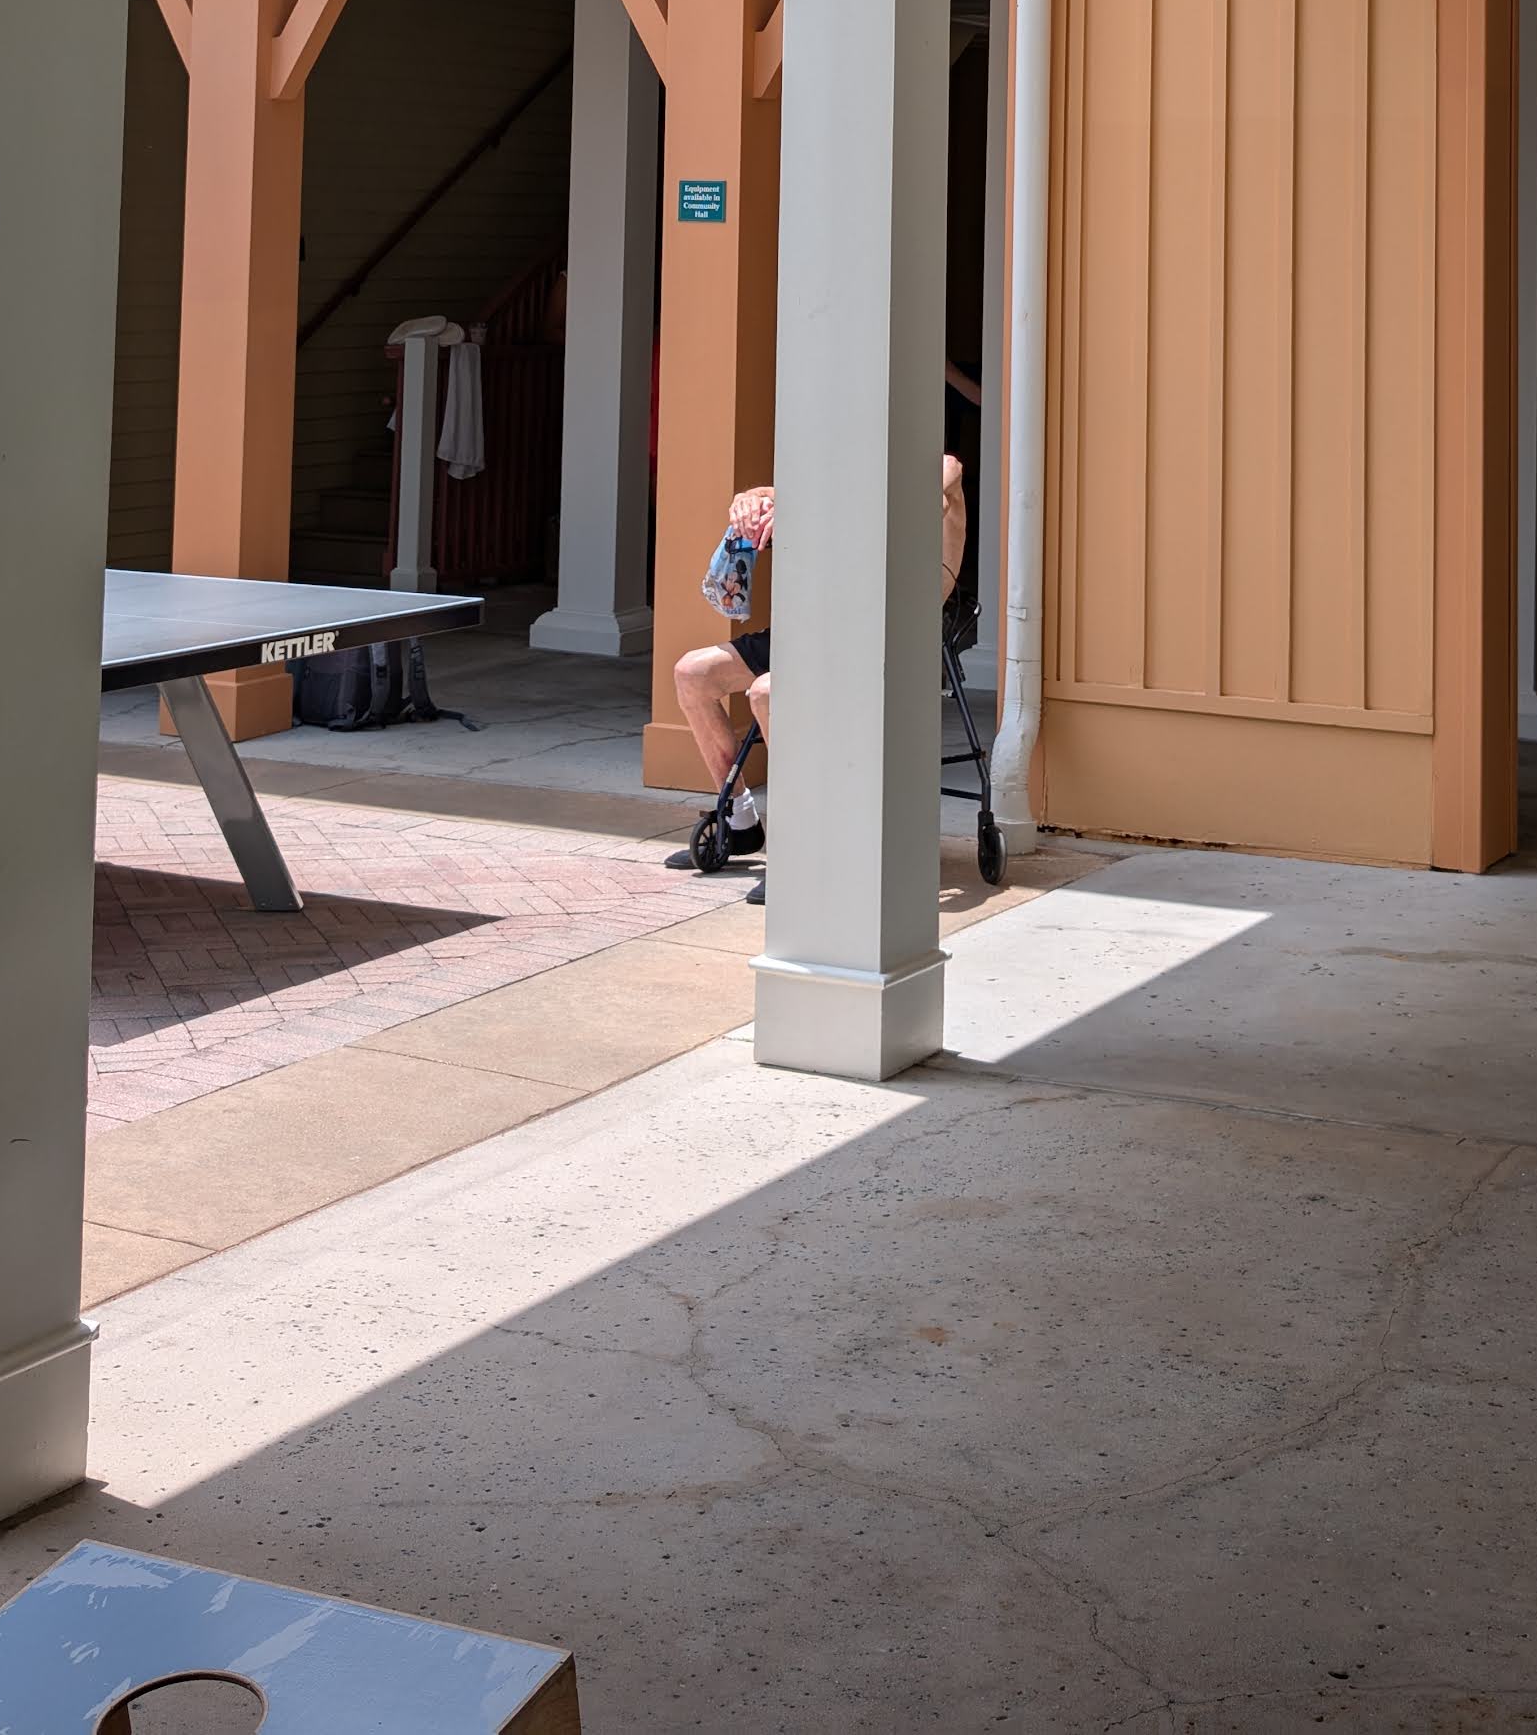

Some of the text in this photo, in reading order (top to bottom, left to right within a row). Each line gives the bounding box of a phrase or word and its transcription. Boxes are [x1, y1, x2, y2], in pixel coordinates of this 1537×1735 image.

[685, 185, 720, 193] Equipment
[683, 202, 720, 211] Community
[261, 631, 336, 664] KETTLER
